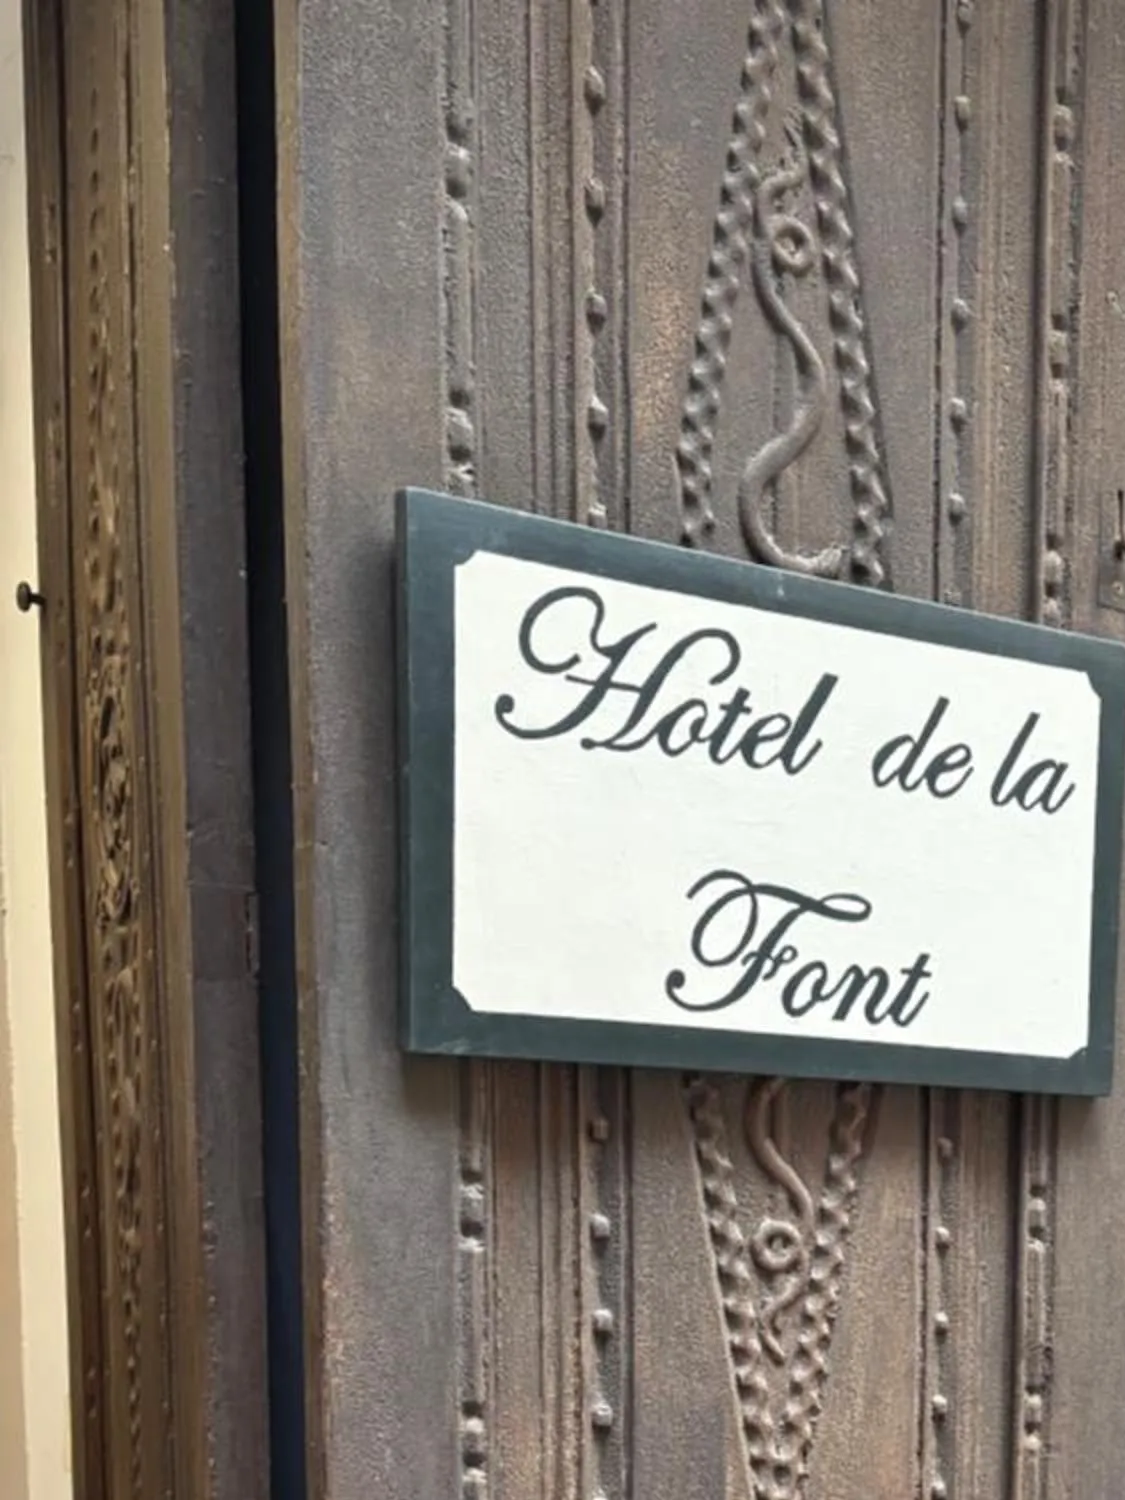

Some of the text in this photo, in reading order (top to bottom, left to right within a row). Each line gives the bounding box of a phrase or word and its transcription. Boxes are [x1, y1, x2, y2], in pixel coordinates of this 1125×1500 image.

[494, 586, 1076, 814] Hotel de la
[665, 869, 932, 1027] Font
